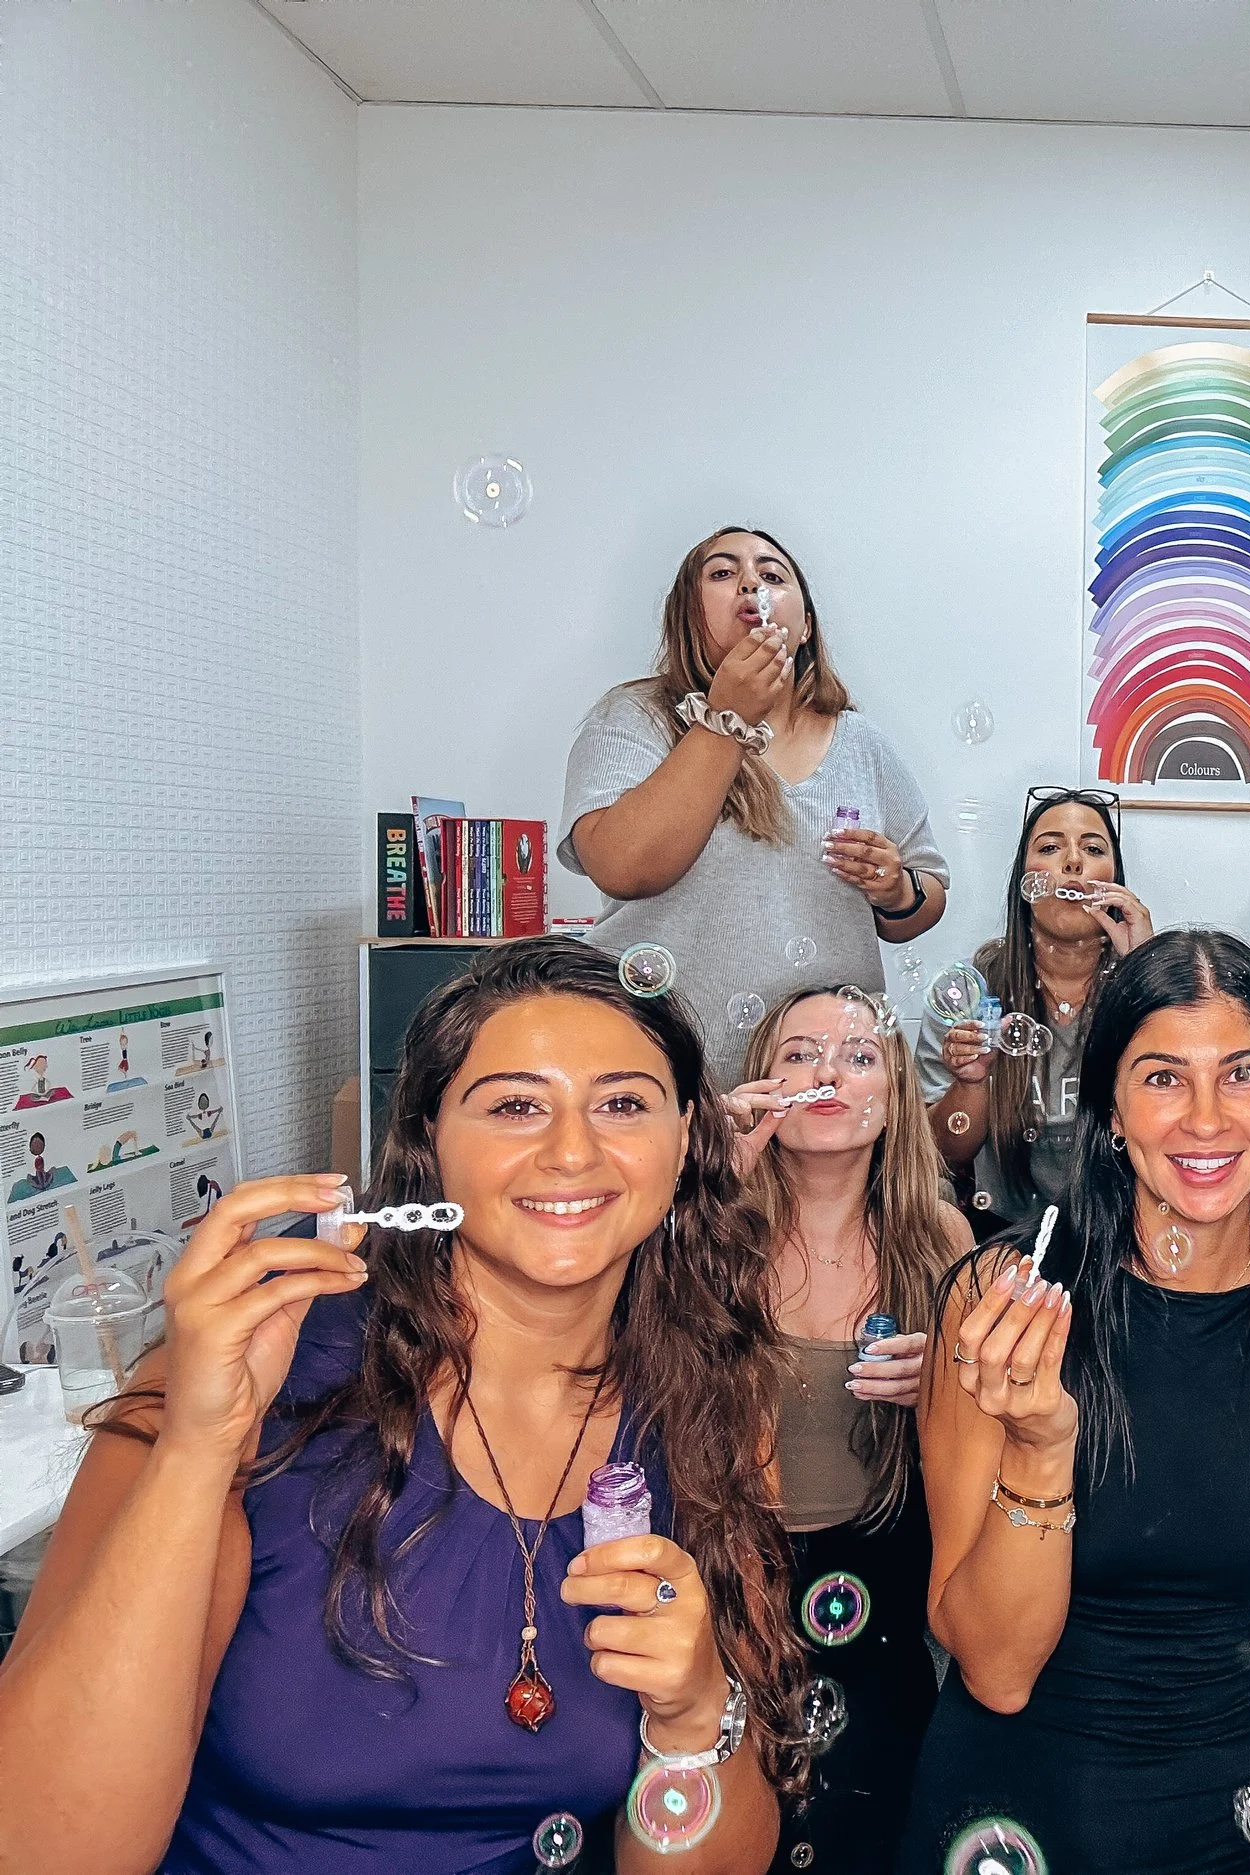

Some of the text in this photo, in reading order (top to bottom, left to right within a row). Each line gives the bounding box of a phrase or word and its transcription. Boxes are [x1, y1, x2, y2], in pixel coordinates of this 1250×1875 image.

[1179, 762, 1221, 776] Colours
[386, 828, 407, 921] BREATHE
[79, 1035, 93, 1044] Tree
[164, 1080, 185, 1092] Sea Bird
[103, 1181, 116, 1192] Legs
[23, 1207, 36, 1217] Dog
